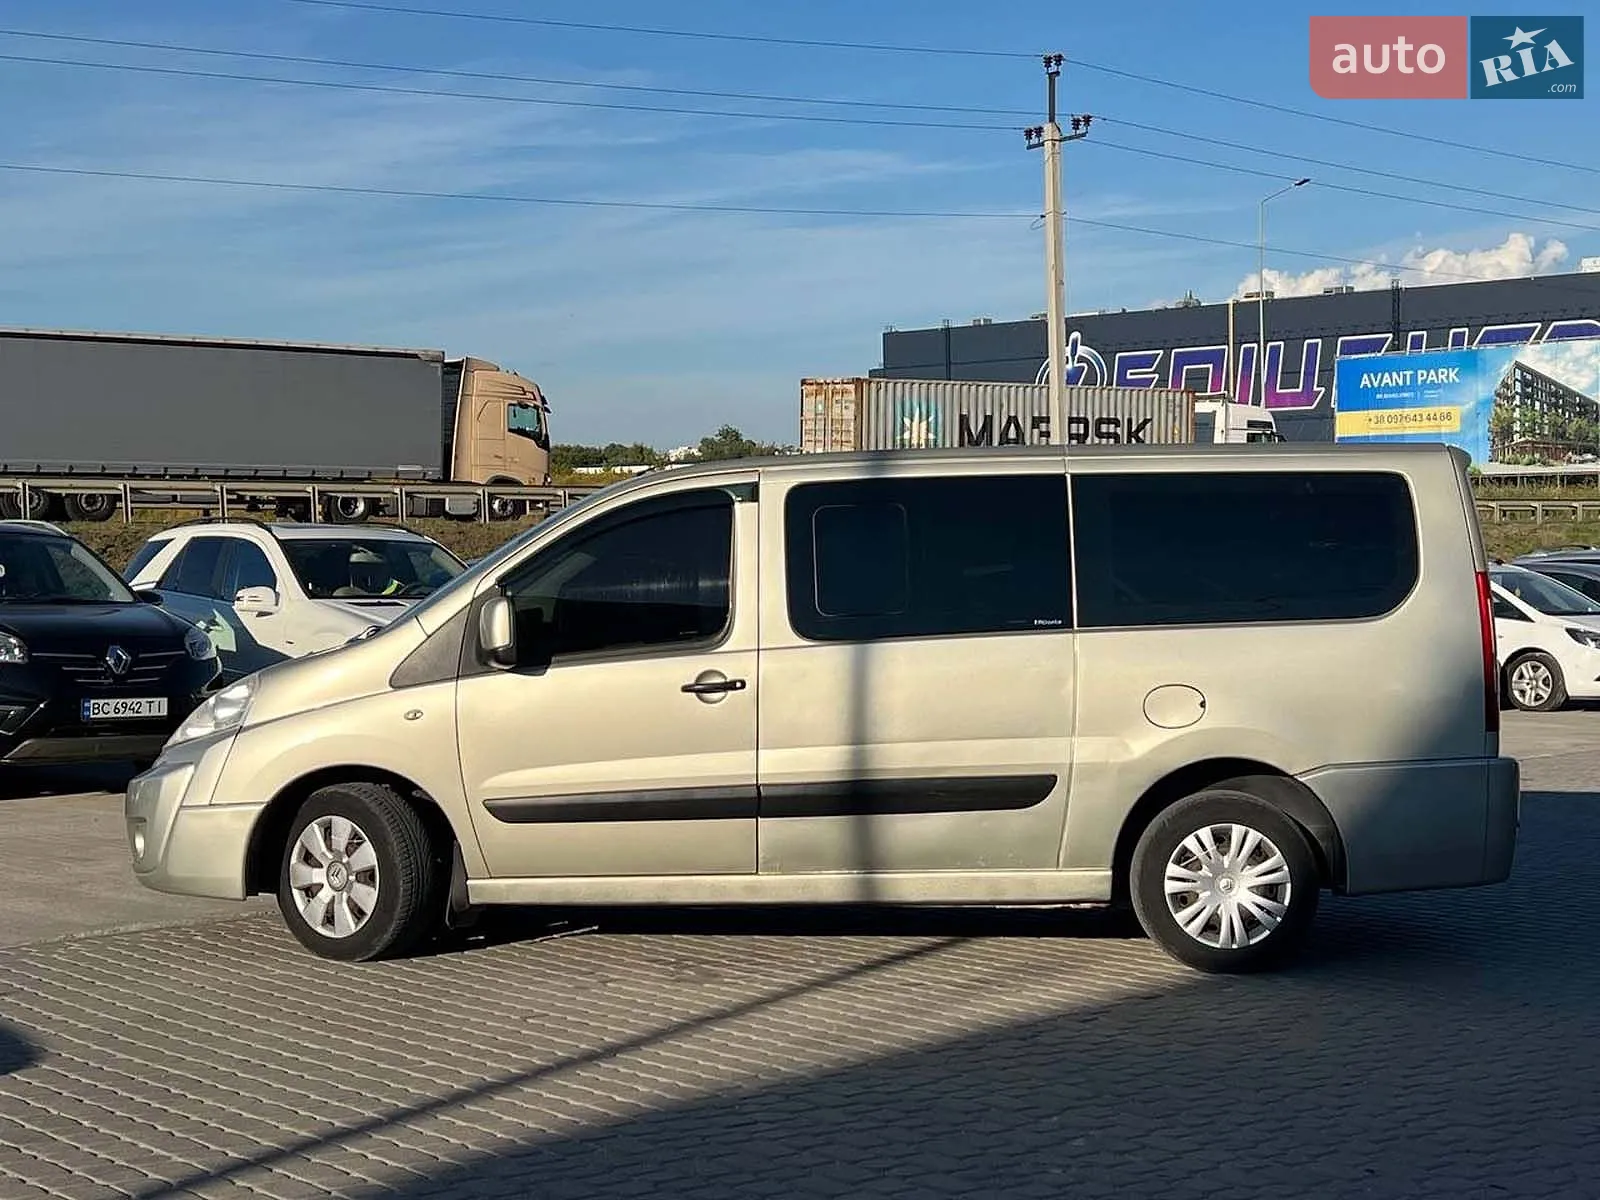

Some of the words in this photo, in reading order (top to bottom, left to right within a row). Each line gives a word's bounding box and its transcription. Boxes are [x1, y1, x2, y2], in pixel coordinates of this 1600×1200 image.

[1360, 371, 1413, 388] AVANT
[1417, 367, 1460, 385] PARK
[92, 702, 110, 715] BC
[113, 701, 143, 714] 6942
[146, 701, 161, 713] TI
